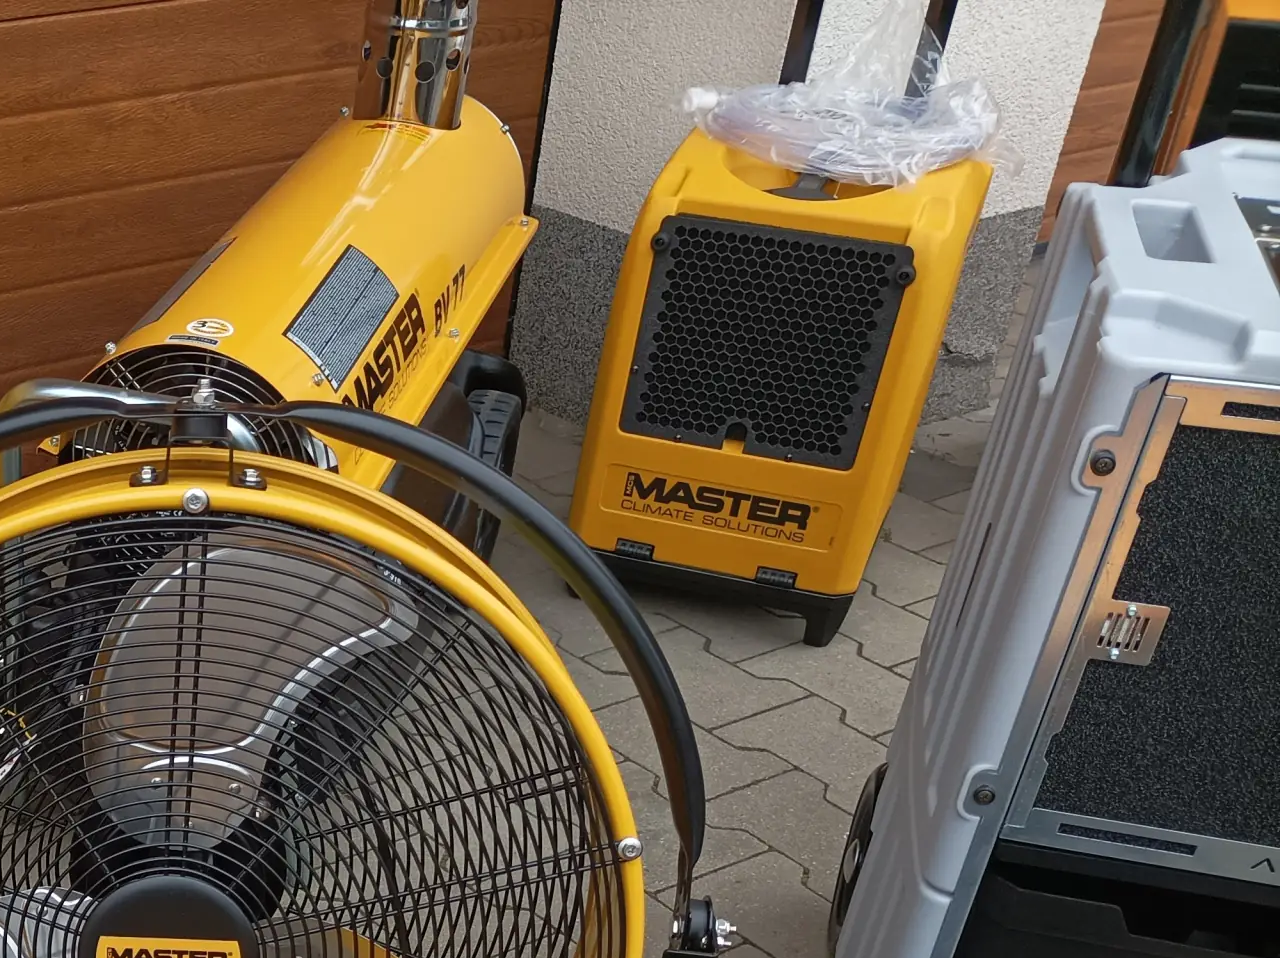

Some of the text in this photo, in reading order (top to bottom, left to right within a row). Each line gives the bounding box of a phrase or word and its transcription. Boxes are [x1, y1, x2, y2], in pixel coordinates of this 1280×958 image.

[434, 264, 466, 338] BV 77
[341, 293, 426, 412] MASTER
[620, 499, 805, 543] CLIMATE SOLUTIONS
[633, 472, 812, 531] MASTER
